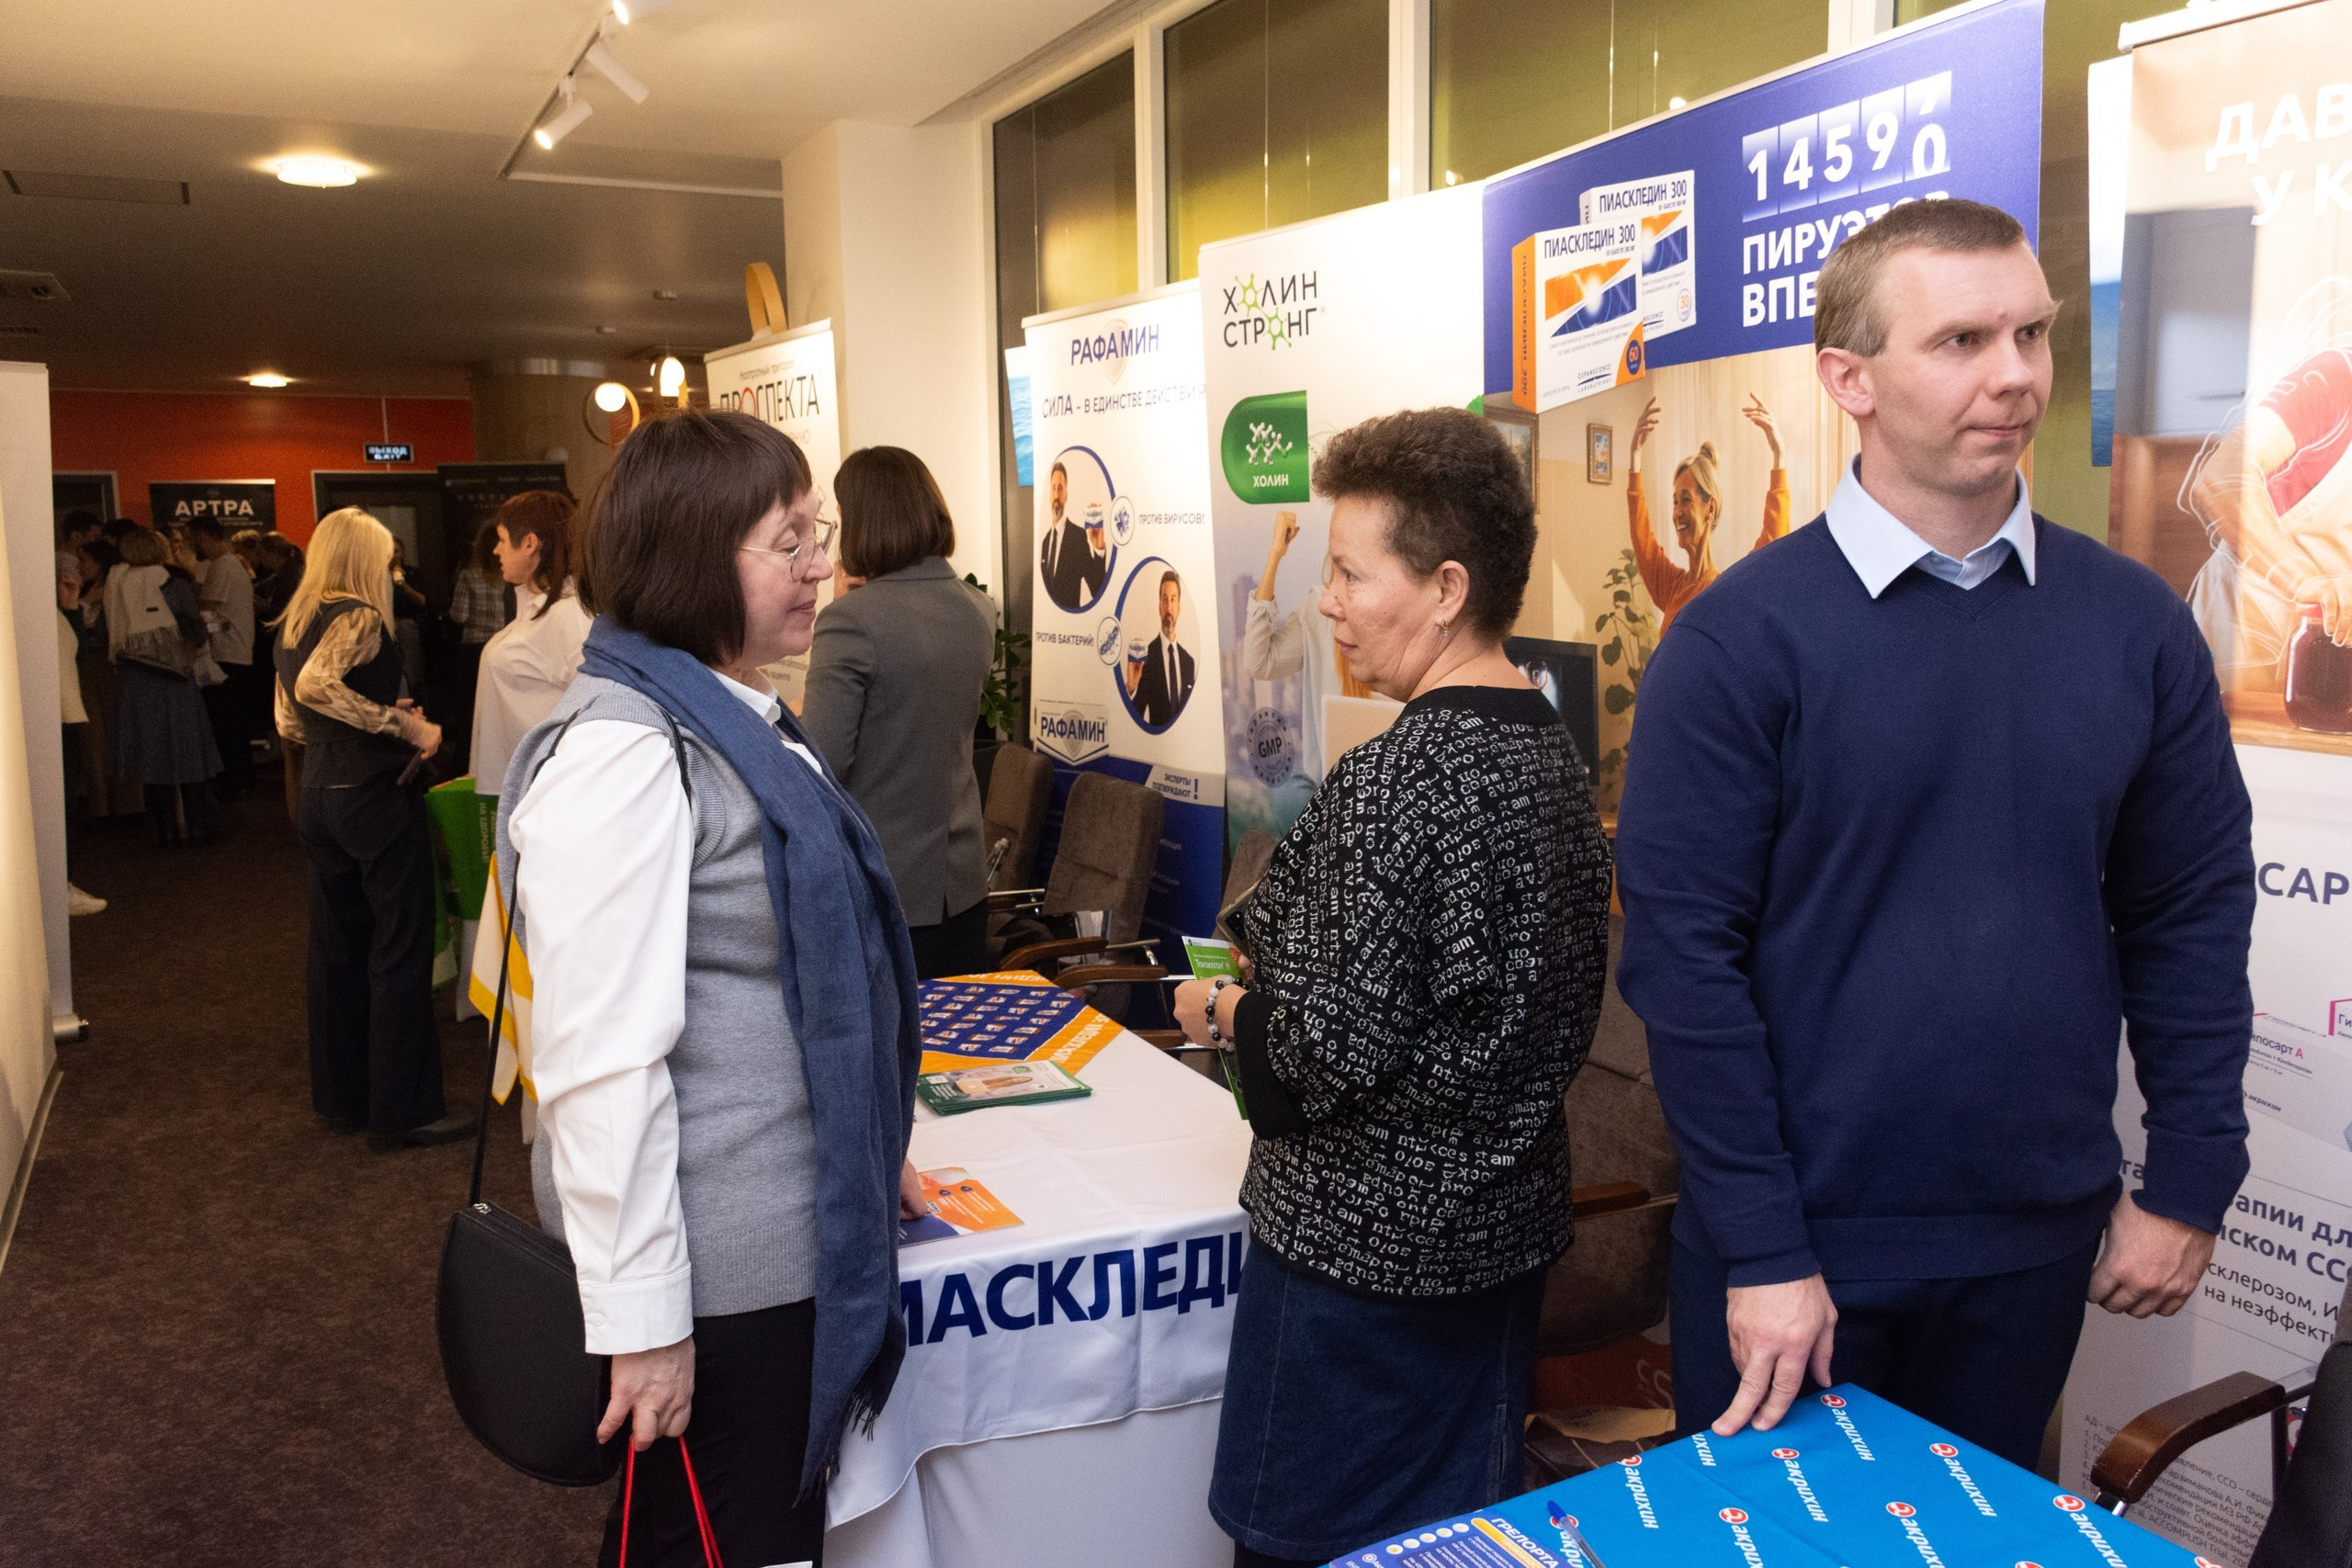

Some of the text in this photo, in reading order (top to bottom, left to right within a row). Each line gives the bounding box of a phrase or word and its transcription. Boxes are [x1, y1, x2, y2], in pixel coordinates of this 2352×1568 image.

[2205, 83, 2352, 173] ДАВ
[1599, 186, 1668, 213] ПИАСКЛЕДИН
[1670, 179, 1688, 199] 300
[2251, 158, 2352, 225] У К
[1544, 227, 1615, 259] ПИАСКЛЕДИН
[1619, 223, 1635, 245] 300
[1743, 189, 1950, 275] ПИРУЭ
[1223, 270, 1317, 317] ХОЛИН
[1679, 293, 1690, 310] 30
[1742, 271, 1820, 328] ВПЕ
[1070, 323, 1159, 367] РАФАМИН
[1223, 307, 1317, 349] СТРОНГ
[1629, 345, 1639, 363] 60
[719, 374, 820, 424] ПРОСПЕКТА
[1042, 393, 1073, 419] СИЛА
[1084, 398, 1091, 413] В
[1093, 391, 1143, 414] ЕДИНСТВЕ
[1253, 473, 1289, 488] ХОЛИН
[175, 500, 254, 516] АРТРА
[1139, 512, 1205, 525] ПРОТИВ ВИРУСОВ!
[1035, 631, 1094, 647] ПРОТИВ БАКТЕРИЙ!
[1041, 716, 1105, 742] РАФАМИН
[1258, 737, 1283, 758] GMP
[2257, 862, 2350, 906] САР
[2338, 1013, 2352, 1028] Ги
[2251, 1033, 2294, 1055] ипосарт
[2121, 1159, 2144, 1180] та
[2234, 1194, 2352, 1250] апии дл
[2219, 1224, 2346, 1283] ском СС
[2208, 1262, 2339, 1322] склерозом, И
[2204, 1284, 2335, 1343] на неэффект
[1691, 1433, 1717, 1467] ихин
[1832, 1407, 1876, 1461] акрихин
[1624, 1467, 1659, 1529] акрихин
[1784, 1459, 1829, 1523] акрихин
[1943, 1456, 1997, 1517] акрихин
[2158, 1477, 2219, 1509] комендации
[2167, 1470, 2224, 1500] арзиманова
[2245, 1489, 2274, 1509] серд
[2152, 1485, 2260, 1540] нические рекомендаци
[1490, 1517, 1560, 1568] ГРЕЛОРТА
[1559, 1530, 1584, 1568] акри
[1731, 1524, 1764, 1568] акрих
[2069, 1512, 2128, 1568] акрихи
[2229, 1532, 2256, 1551] эфф
[2231, 1555, 2249, 1568] 20
